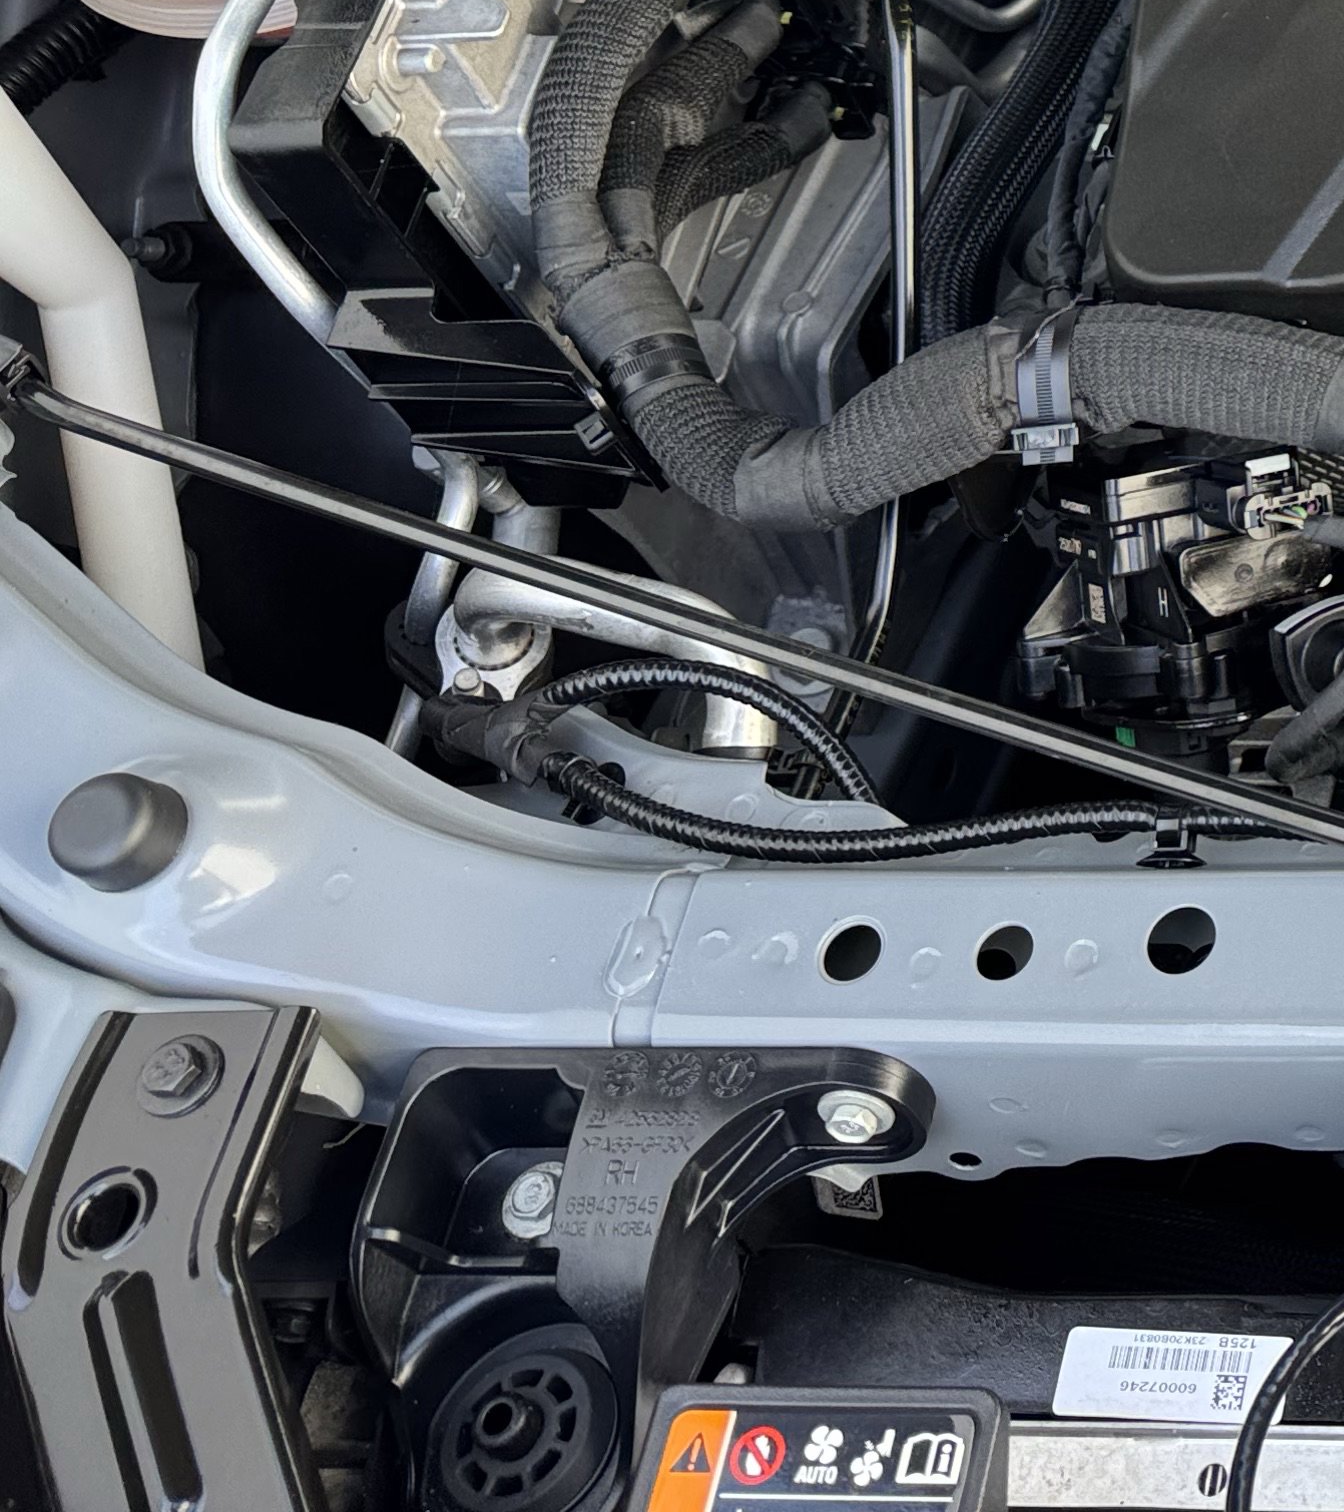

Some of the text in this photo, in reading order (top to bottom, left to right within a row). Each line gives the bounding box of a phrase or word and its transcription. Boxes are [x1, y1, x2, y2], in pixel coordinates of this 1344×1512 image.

[604, 1158, 640, 1185] RH
[594, 1221, 607, 1236] IN
[612, 1221, 653, 1236] KOREA
[1119, 1380, 1198, 1395] 60007246
[794, 1465, 838, 1485] AUTO
